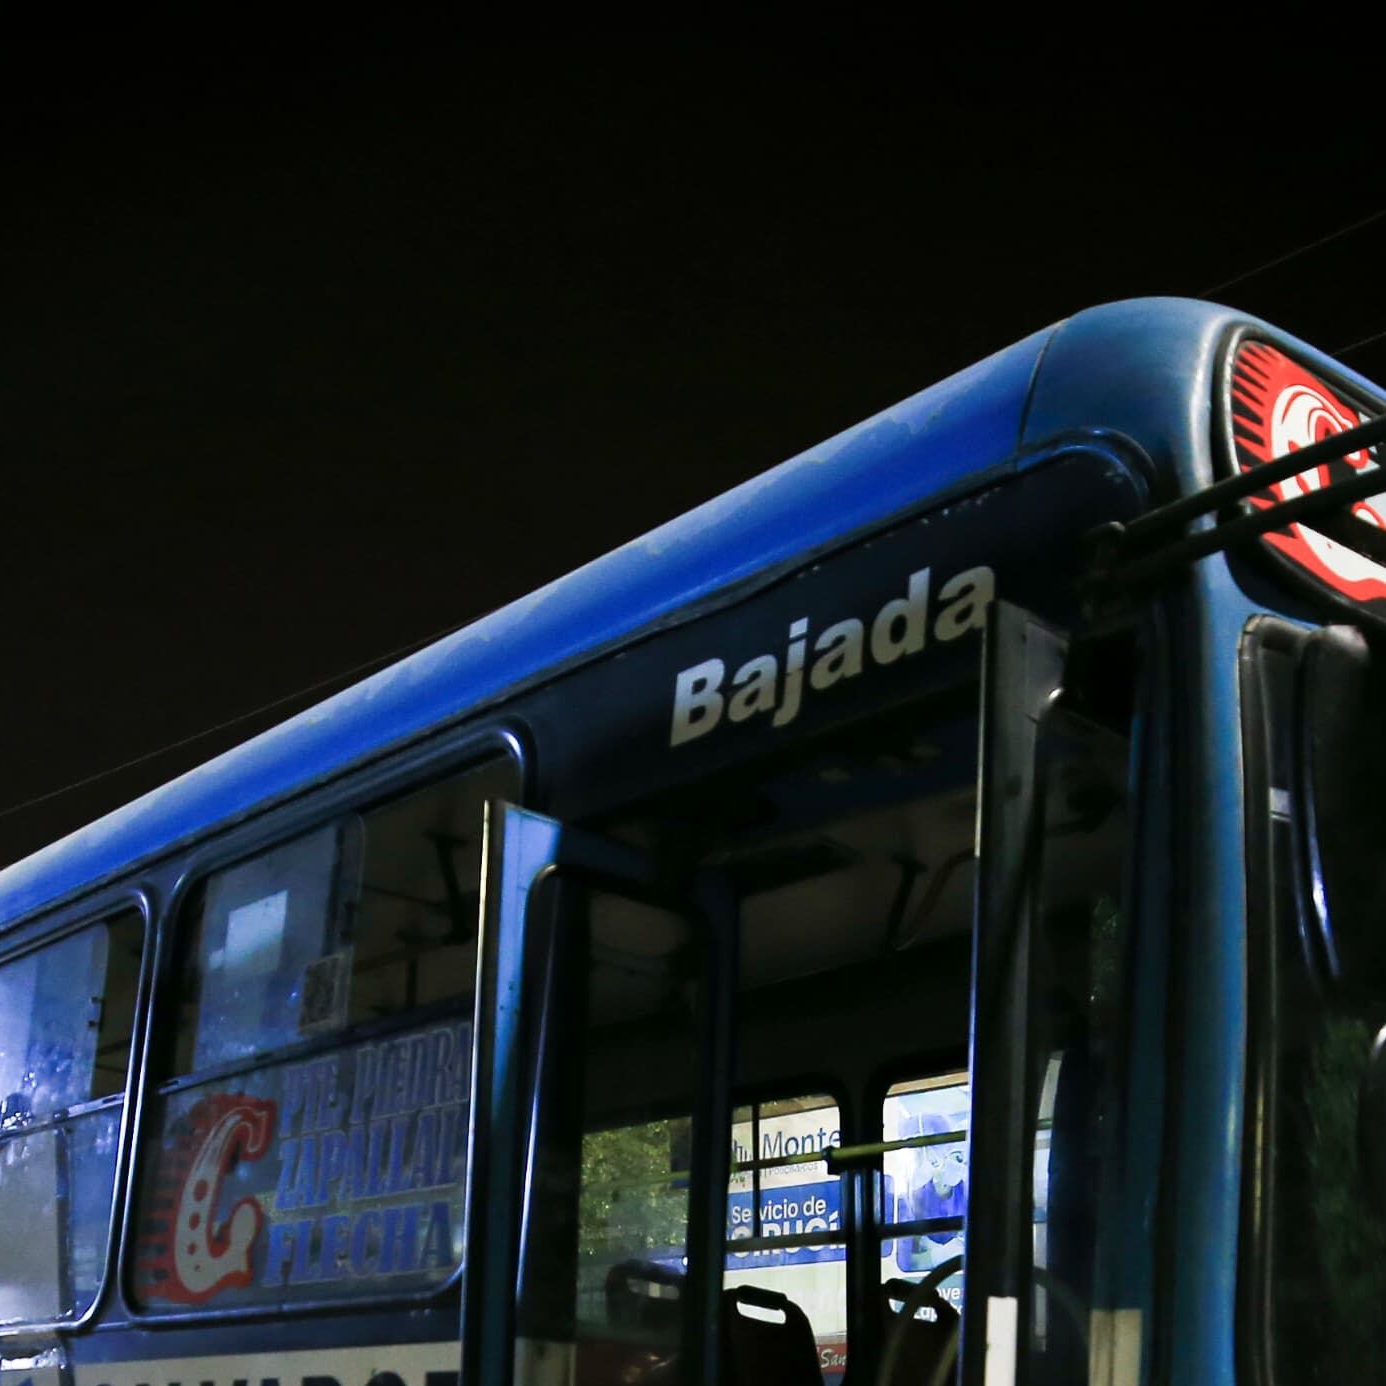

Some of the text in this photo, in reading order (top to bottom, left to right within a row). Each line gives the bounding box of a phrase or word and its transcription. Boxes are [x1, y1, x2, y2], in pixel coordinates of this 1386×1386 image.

[670, 565, 996, 748] Bajada
[261, 1202, 456, 1287] FLECHA
[732, 1195, 826, 1223] Sevicio de
